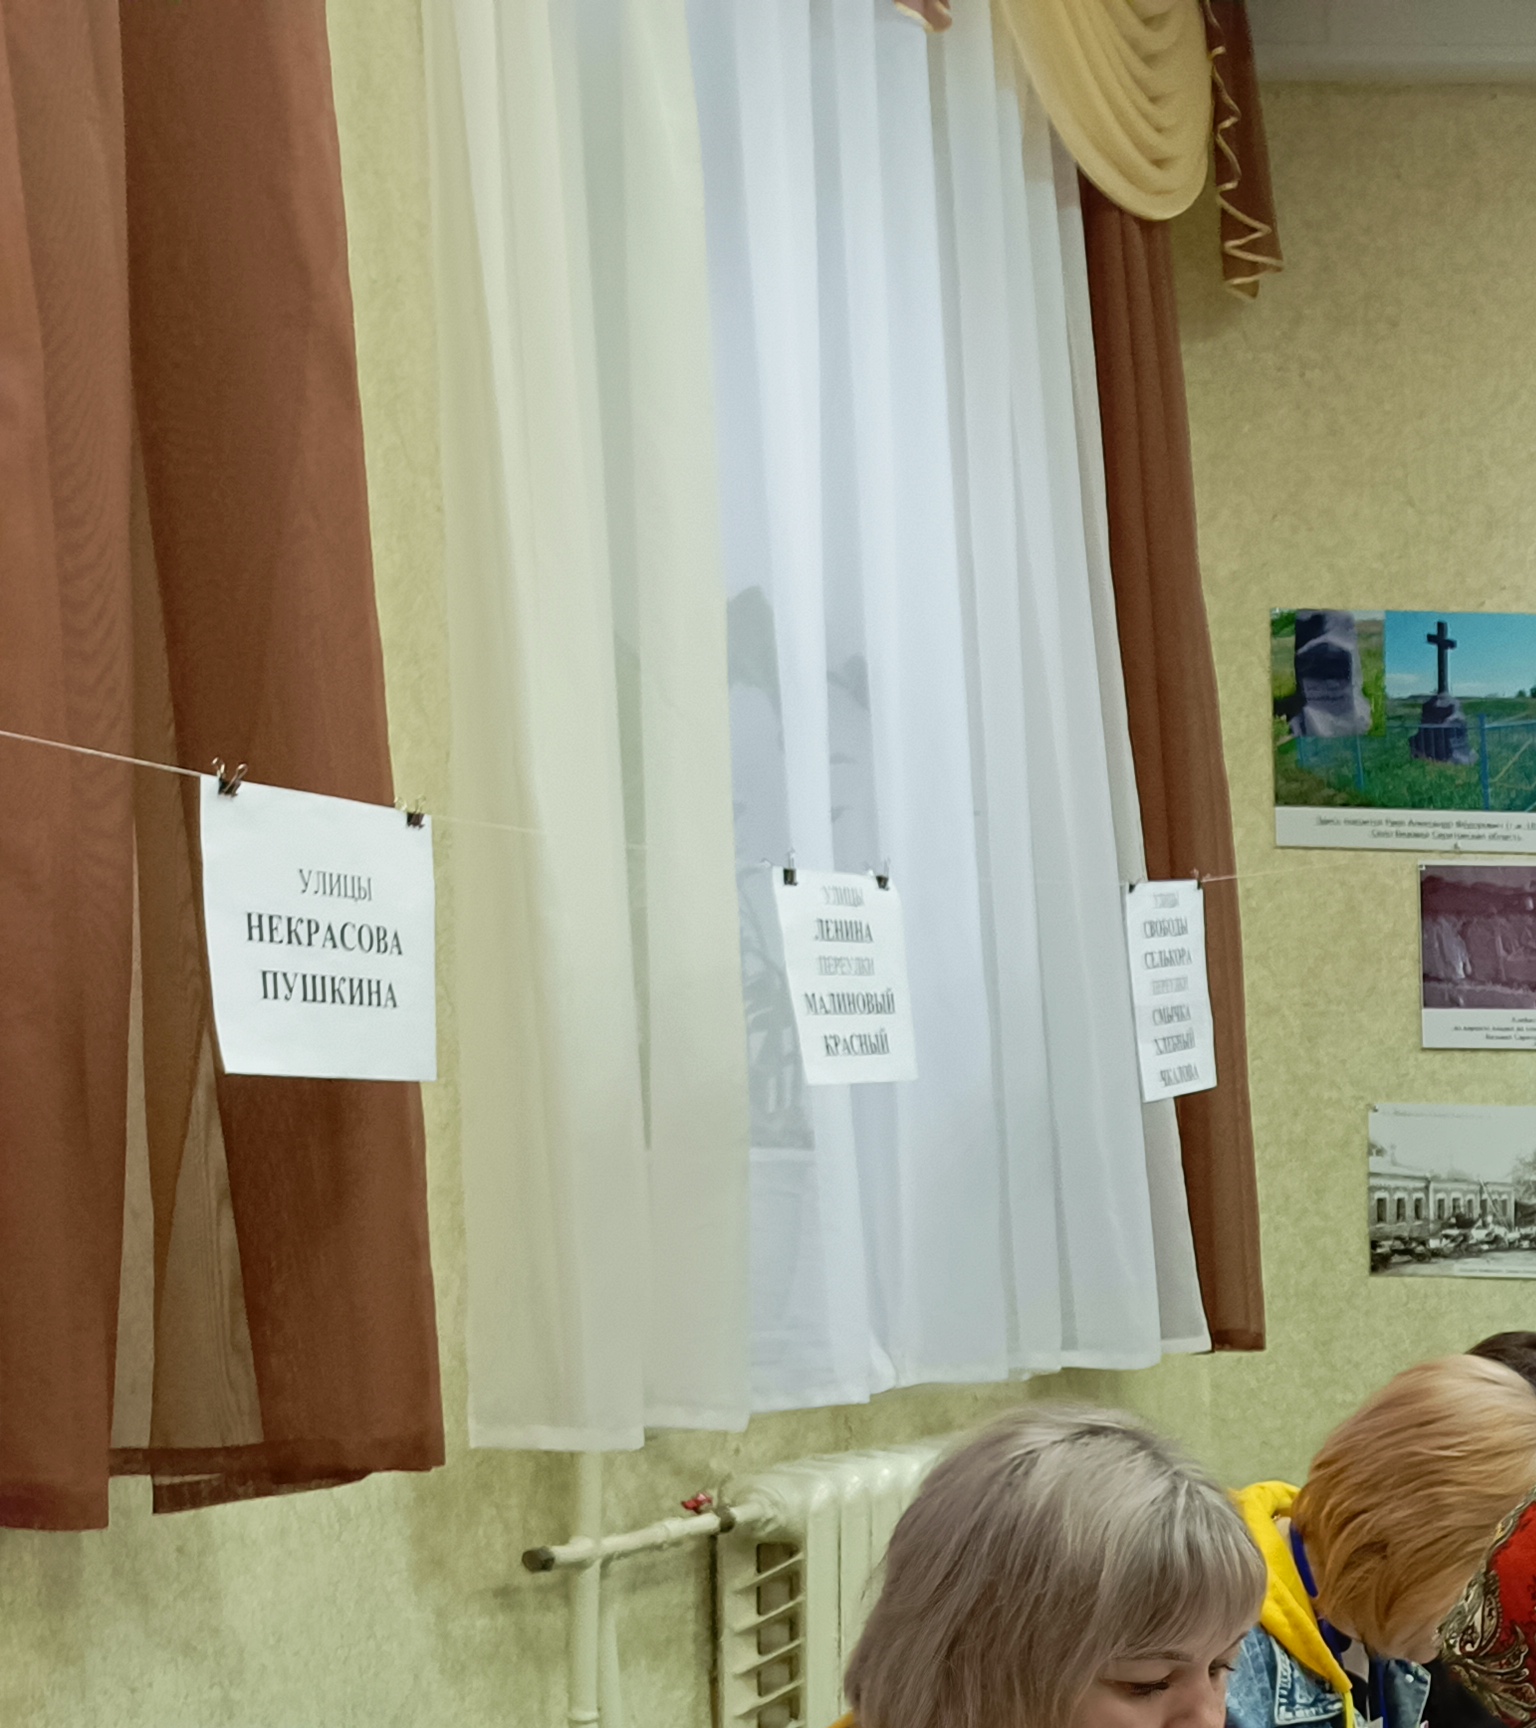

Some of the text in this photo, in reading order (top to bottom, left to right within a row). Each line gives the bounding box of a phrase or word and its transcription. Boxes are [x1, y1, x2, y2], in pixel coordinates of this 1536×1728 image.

[298, 868, 373, 902] УЛИЦЫ
[822, 885, 865, 907] УЛИЦЫ
[246, 911, 404, 956] НЕКРАСОВА
[814, 918, 875, 944] ЛЕНИНА
[1143, 916, 1189, 939] СВОБОДЫ
[261, 970, 399, 1009] ПУШКИНА
[804, 987, 897, 1016] МАЛИНОВЫЙ
[824, 1027, 890, 1057] КРАСНЫЙ
